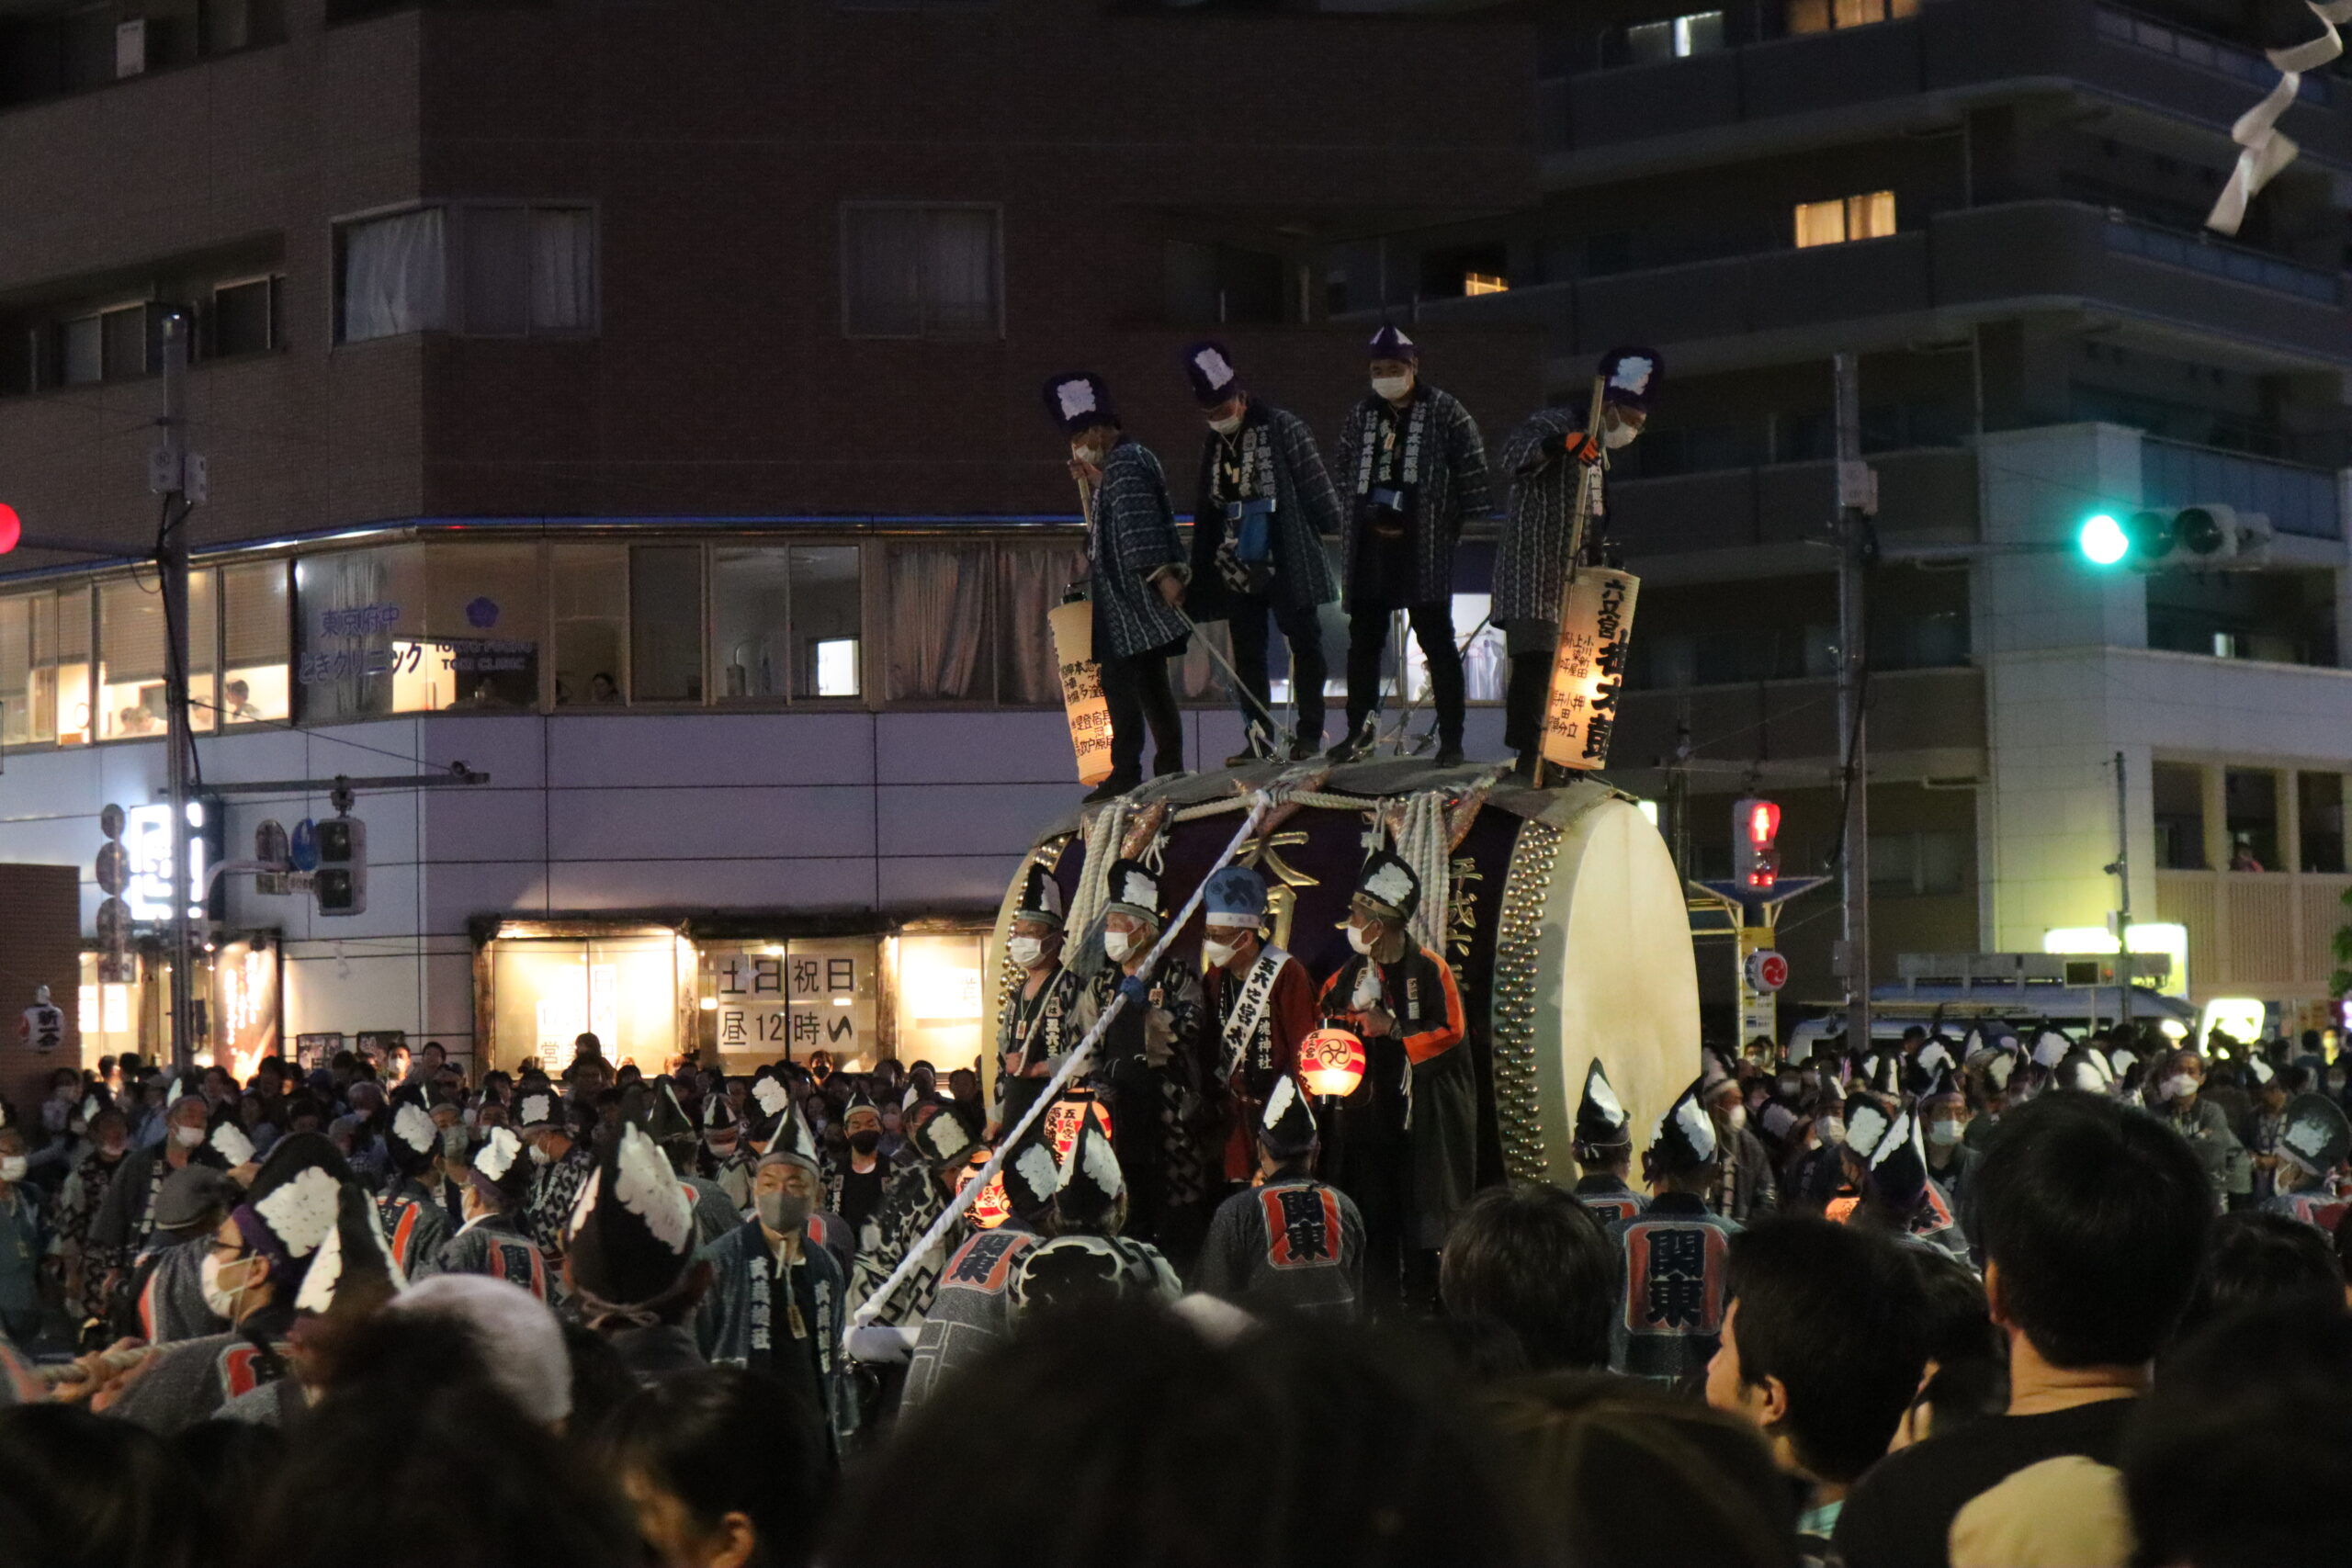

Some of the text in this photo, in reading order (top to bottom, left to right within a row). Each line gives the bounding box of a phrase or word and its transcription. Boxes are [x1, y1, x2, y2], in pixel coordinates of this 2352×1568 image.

[321, 602, 401, 638] 東京府中
[299, 641, 422, 684] ときクリニック
[721, 958, 854, 995] 土日祝日
